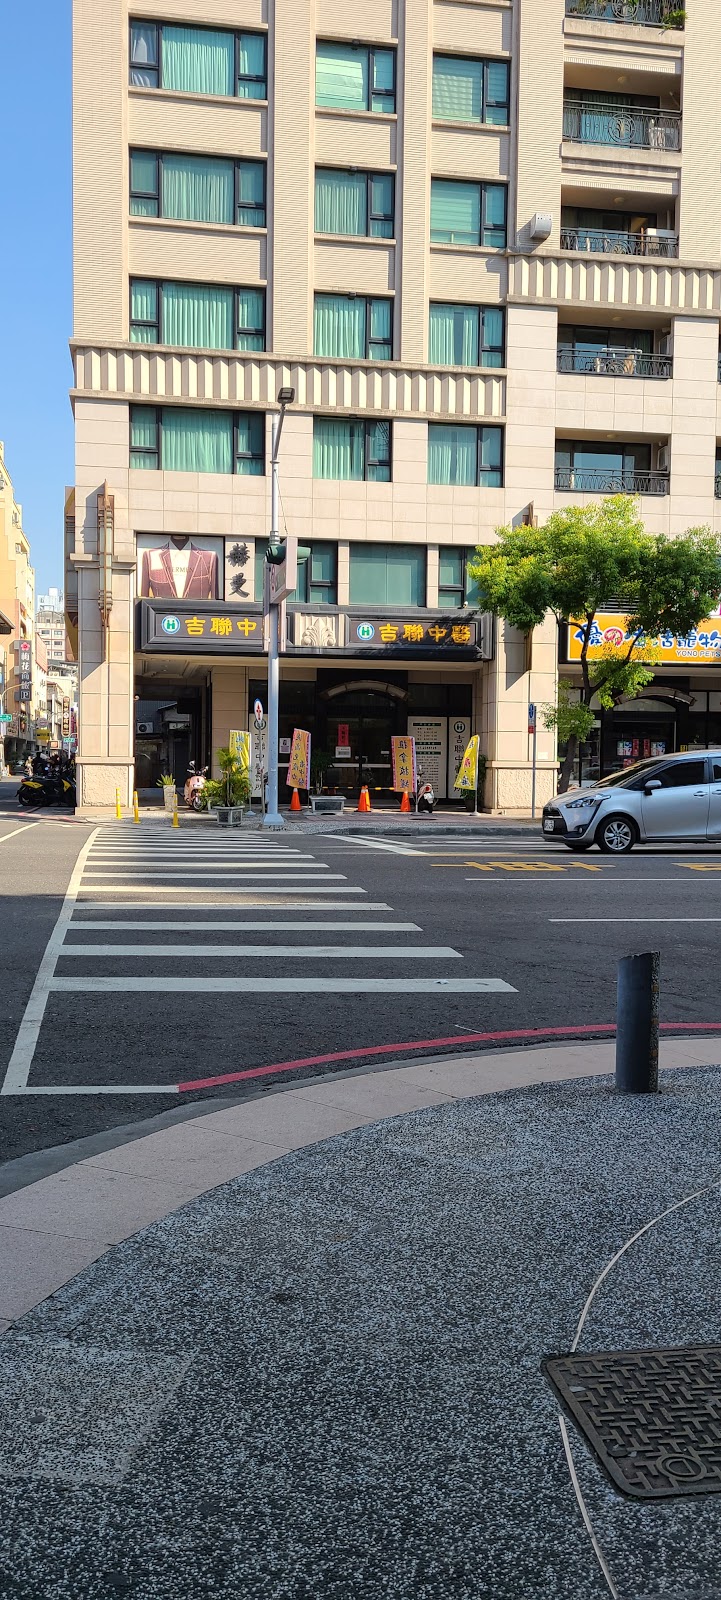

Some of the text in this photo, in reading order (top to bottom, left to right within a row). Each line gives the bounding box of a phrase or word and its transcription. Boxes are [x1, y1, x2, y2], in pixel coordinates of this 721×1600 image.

[184, 616, 281, 638] 吉聯中
[379, 622, 471, 644] 吉聯中醫
